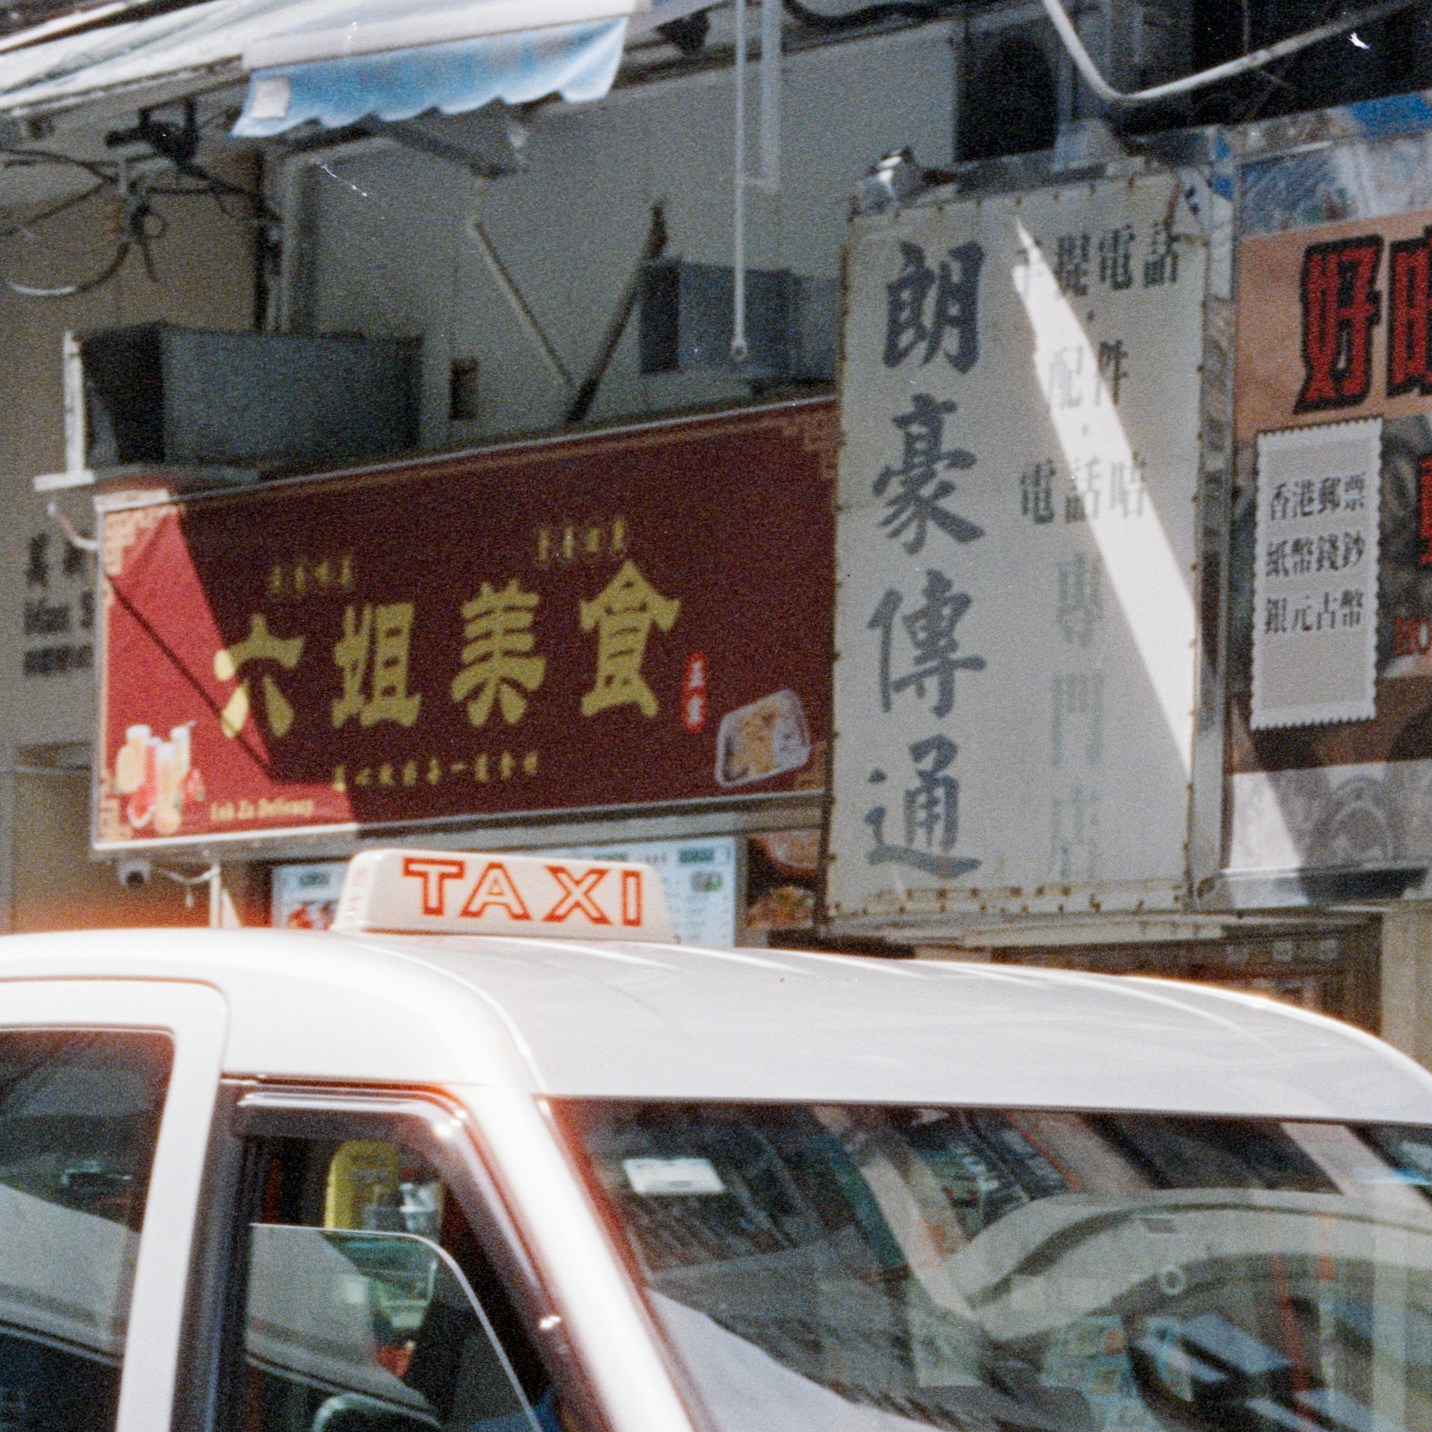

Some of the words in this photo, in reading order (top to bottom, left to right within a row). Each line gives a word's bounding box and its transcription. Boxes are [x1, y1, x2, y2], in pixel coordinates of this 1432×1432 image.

[1268, 472, 1366, 521] 香港郵票
[866, 239, 987, 878] 朗豪傳通
[214, 561, 682, 738] 六姐美食
[1395, 614, 1432, 655] HO
[402, 857, 643, 928] TAXI
